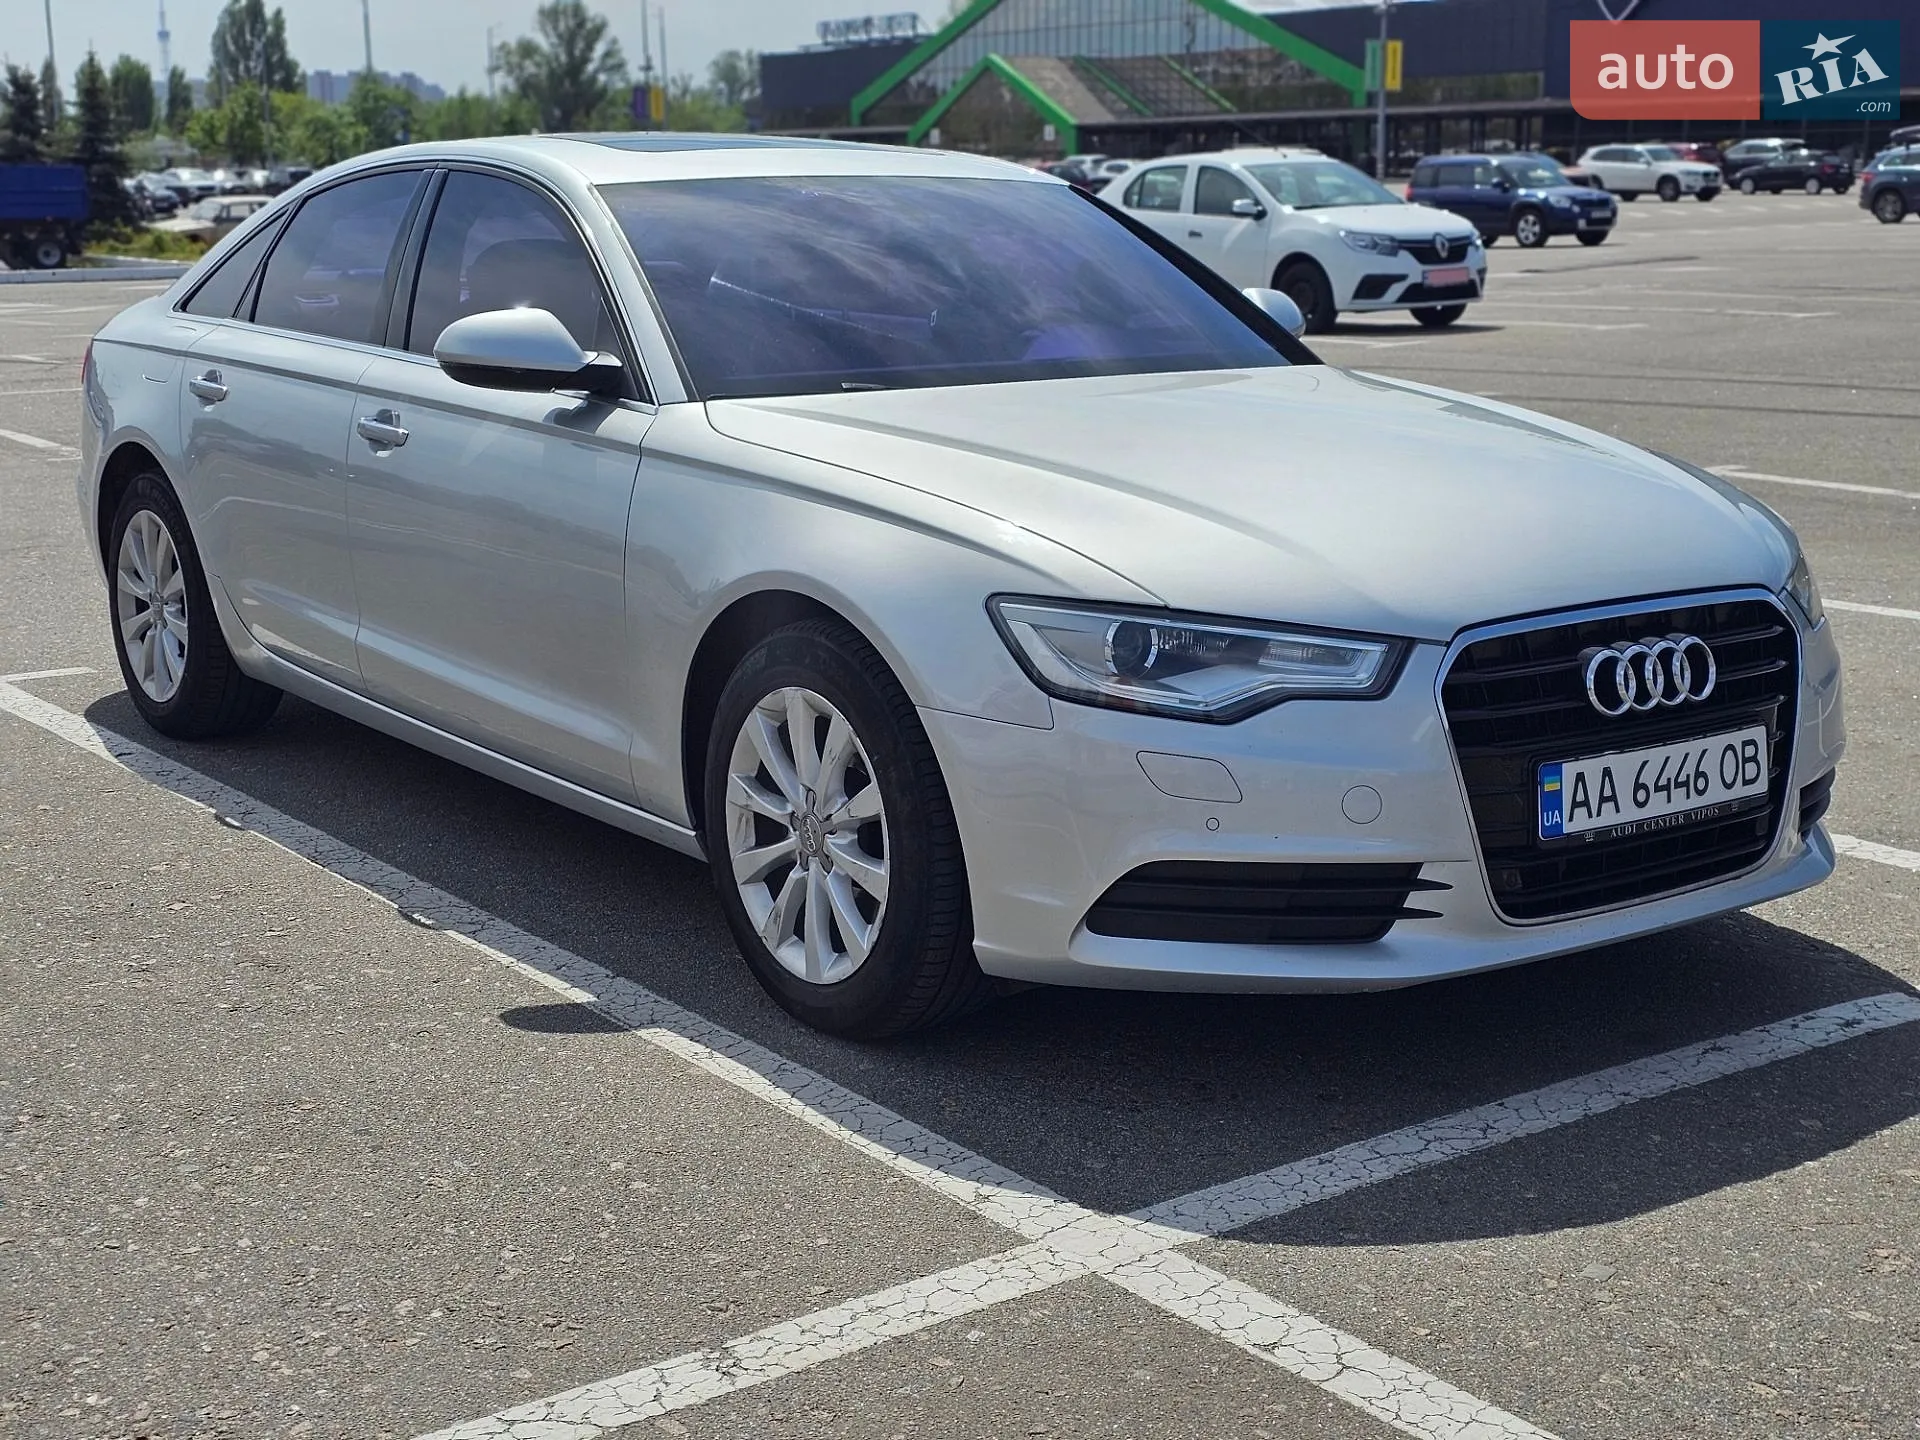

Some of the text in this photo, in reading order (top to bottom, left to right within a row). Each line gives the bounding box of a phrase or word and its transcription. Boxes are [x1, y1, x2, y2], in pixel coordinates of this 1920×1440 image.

[1568, 738, 1762, 822] AA 6446 OB
[1543, 810, 1562, 826] UA
[1610, 806, 1720, 838] AUDI CENTER VIPOS
